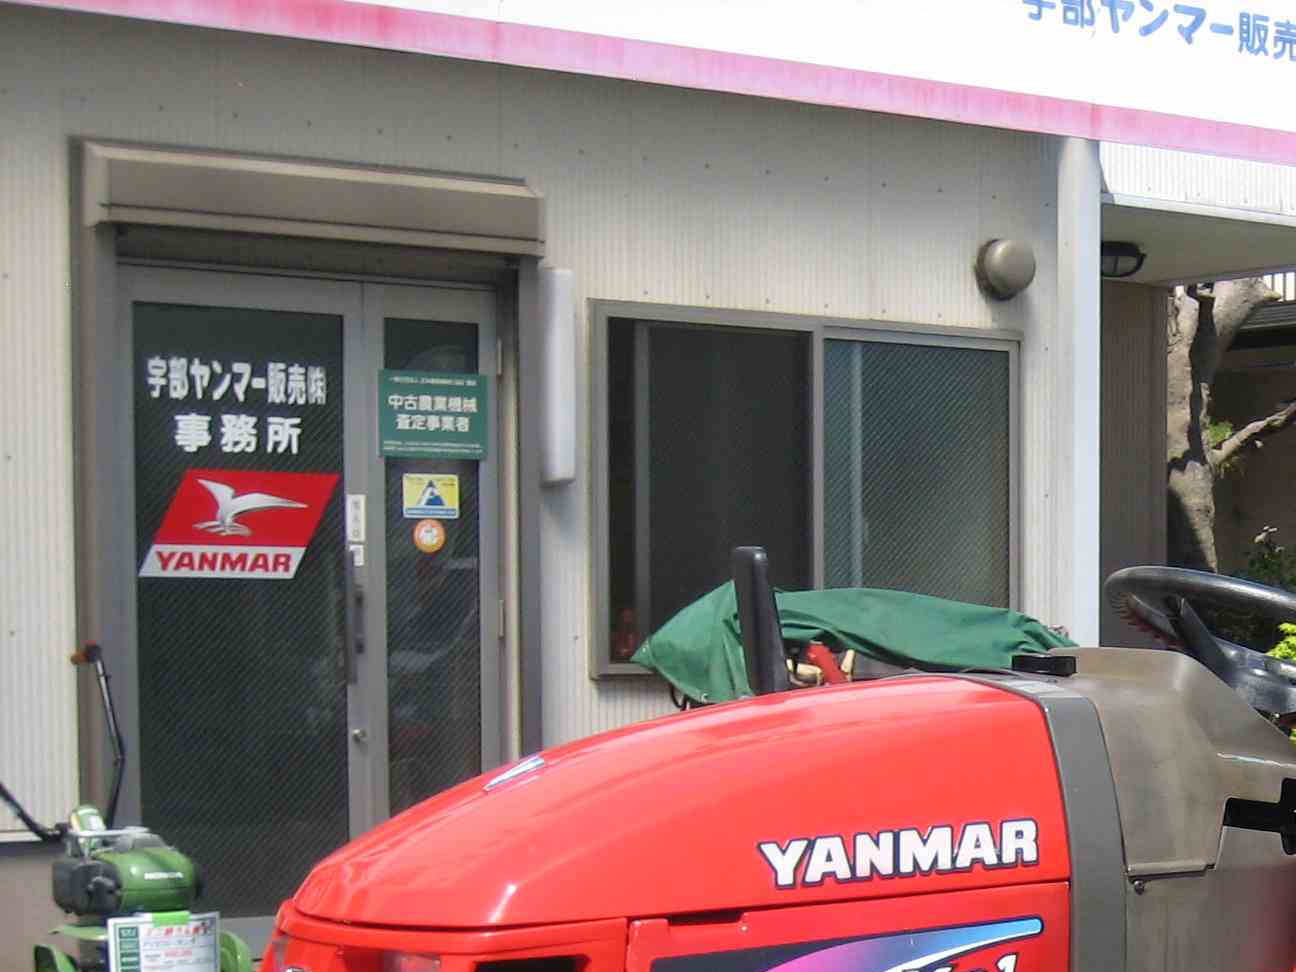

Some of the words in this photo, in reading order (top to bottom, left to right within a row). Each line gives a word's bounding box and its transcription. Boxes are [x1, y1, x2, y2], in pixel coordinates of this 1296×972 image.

[174, 413, 302, 455] 事務所
[155, 550, 292, 574] YANMAR
[758, 818, 1039, 889] YANMAR
